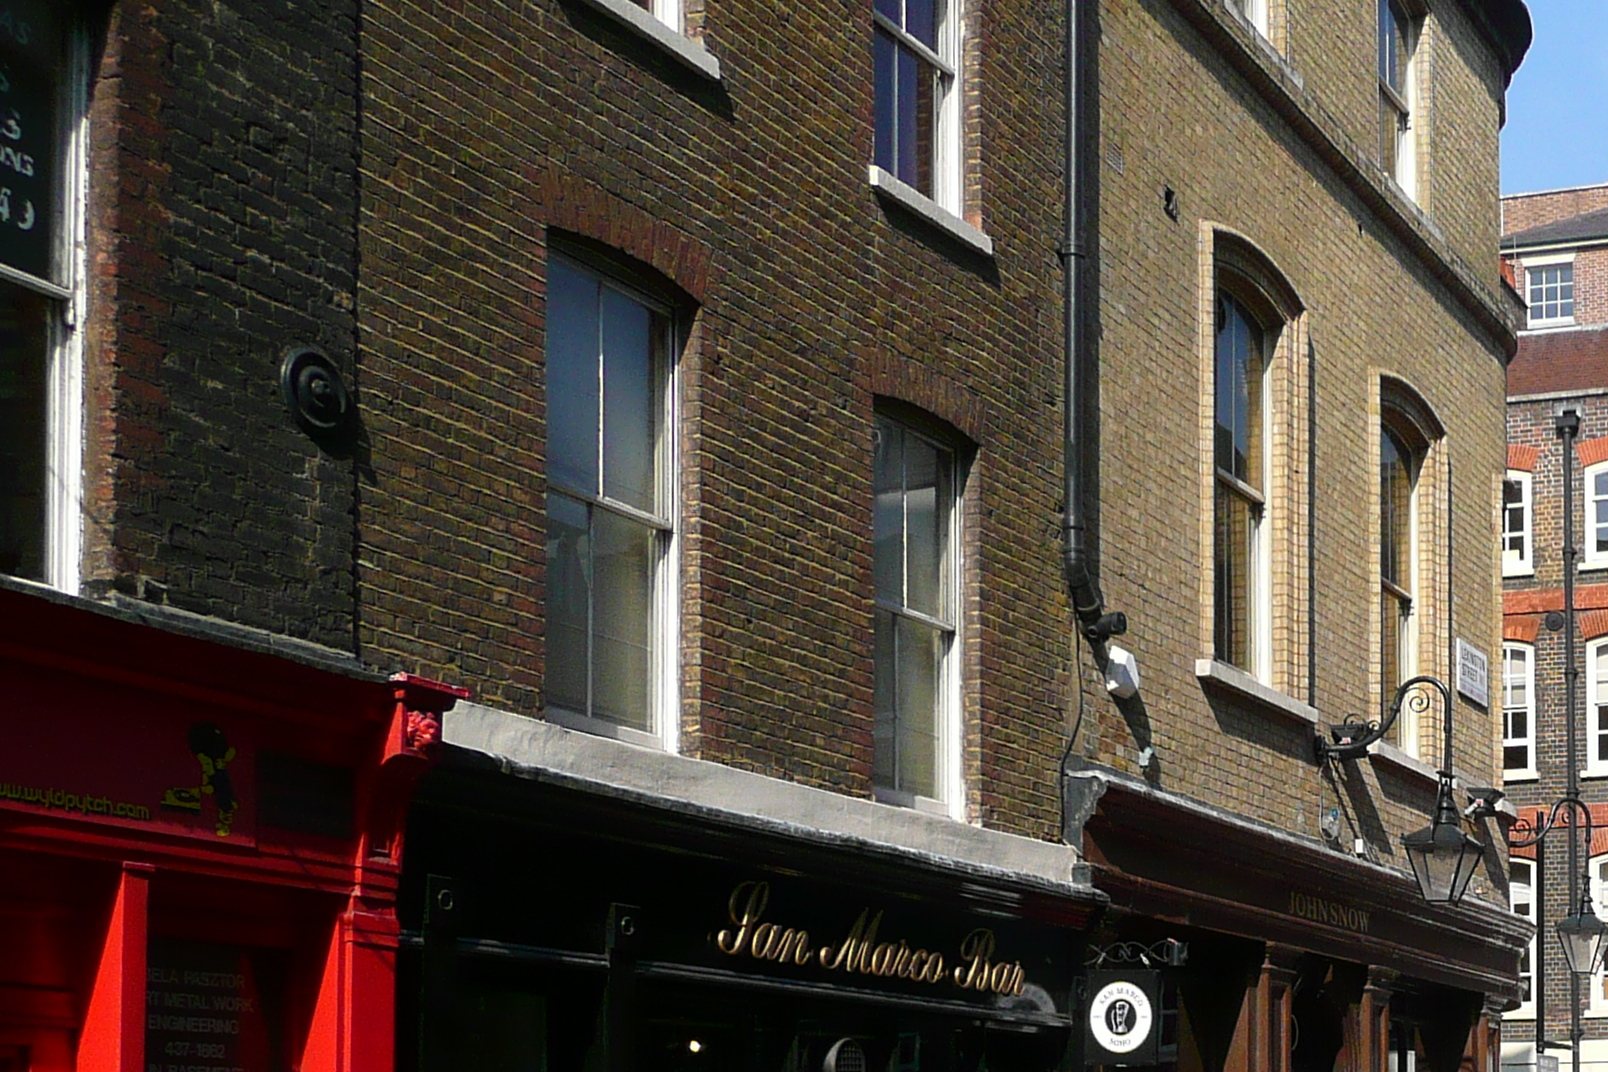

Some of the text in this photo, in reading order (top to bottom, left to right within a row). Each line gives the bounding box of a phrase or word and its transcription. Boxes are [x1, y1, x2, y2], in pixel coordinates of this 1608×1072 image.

[1288, 891, 1370, 933] JOHN SNOW
[716, 880, 1027, 997] San Marco Bar
[164, 992, 210, 1009] METAL
[1099, 987, 1143, 1006] SAN MARCO
[148, 1014, 240, 1035] ENGINEERING
[1109, 1037, 1131, 1047] SOHO
